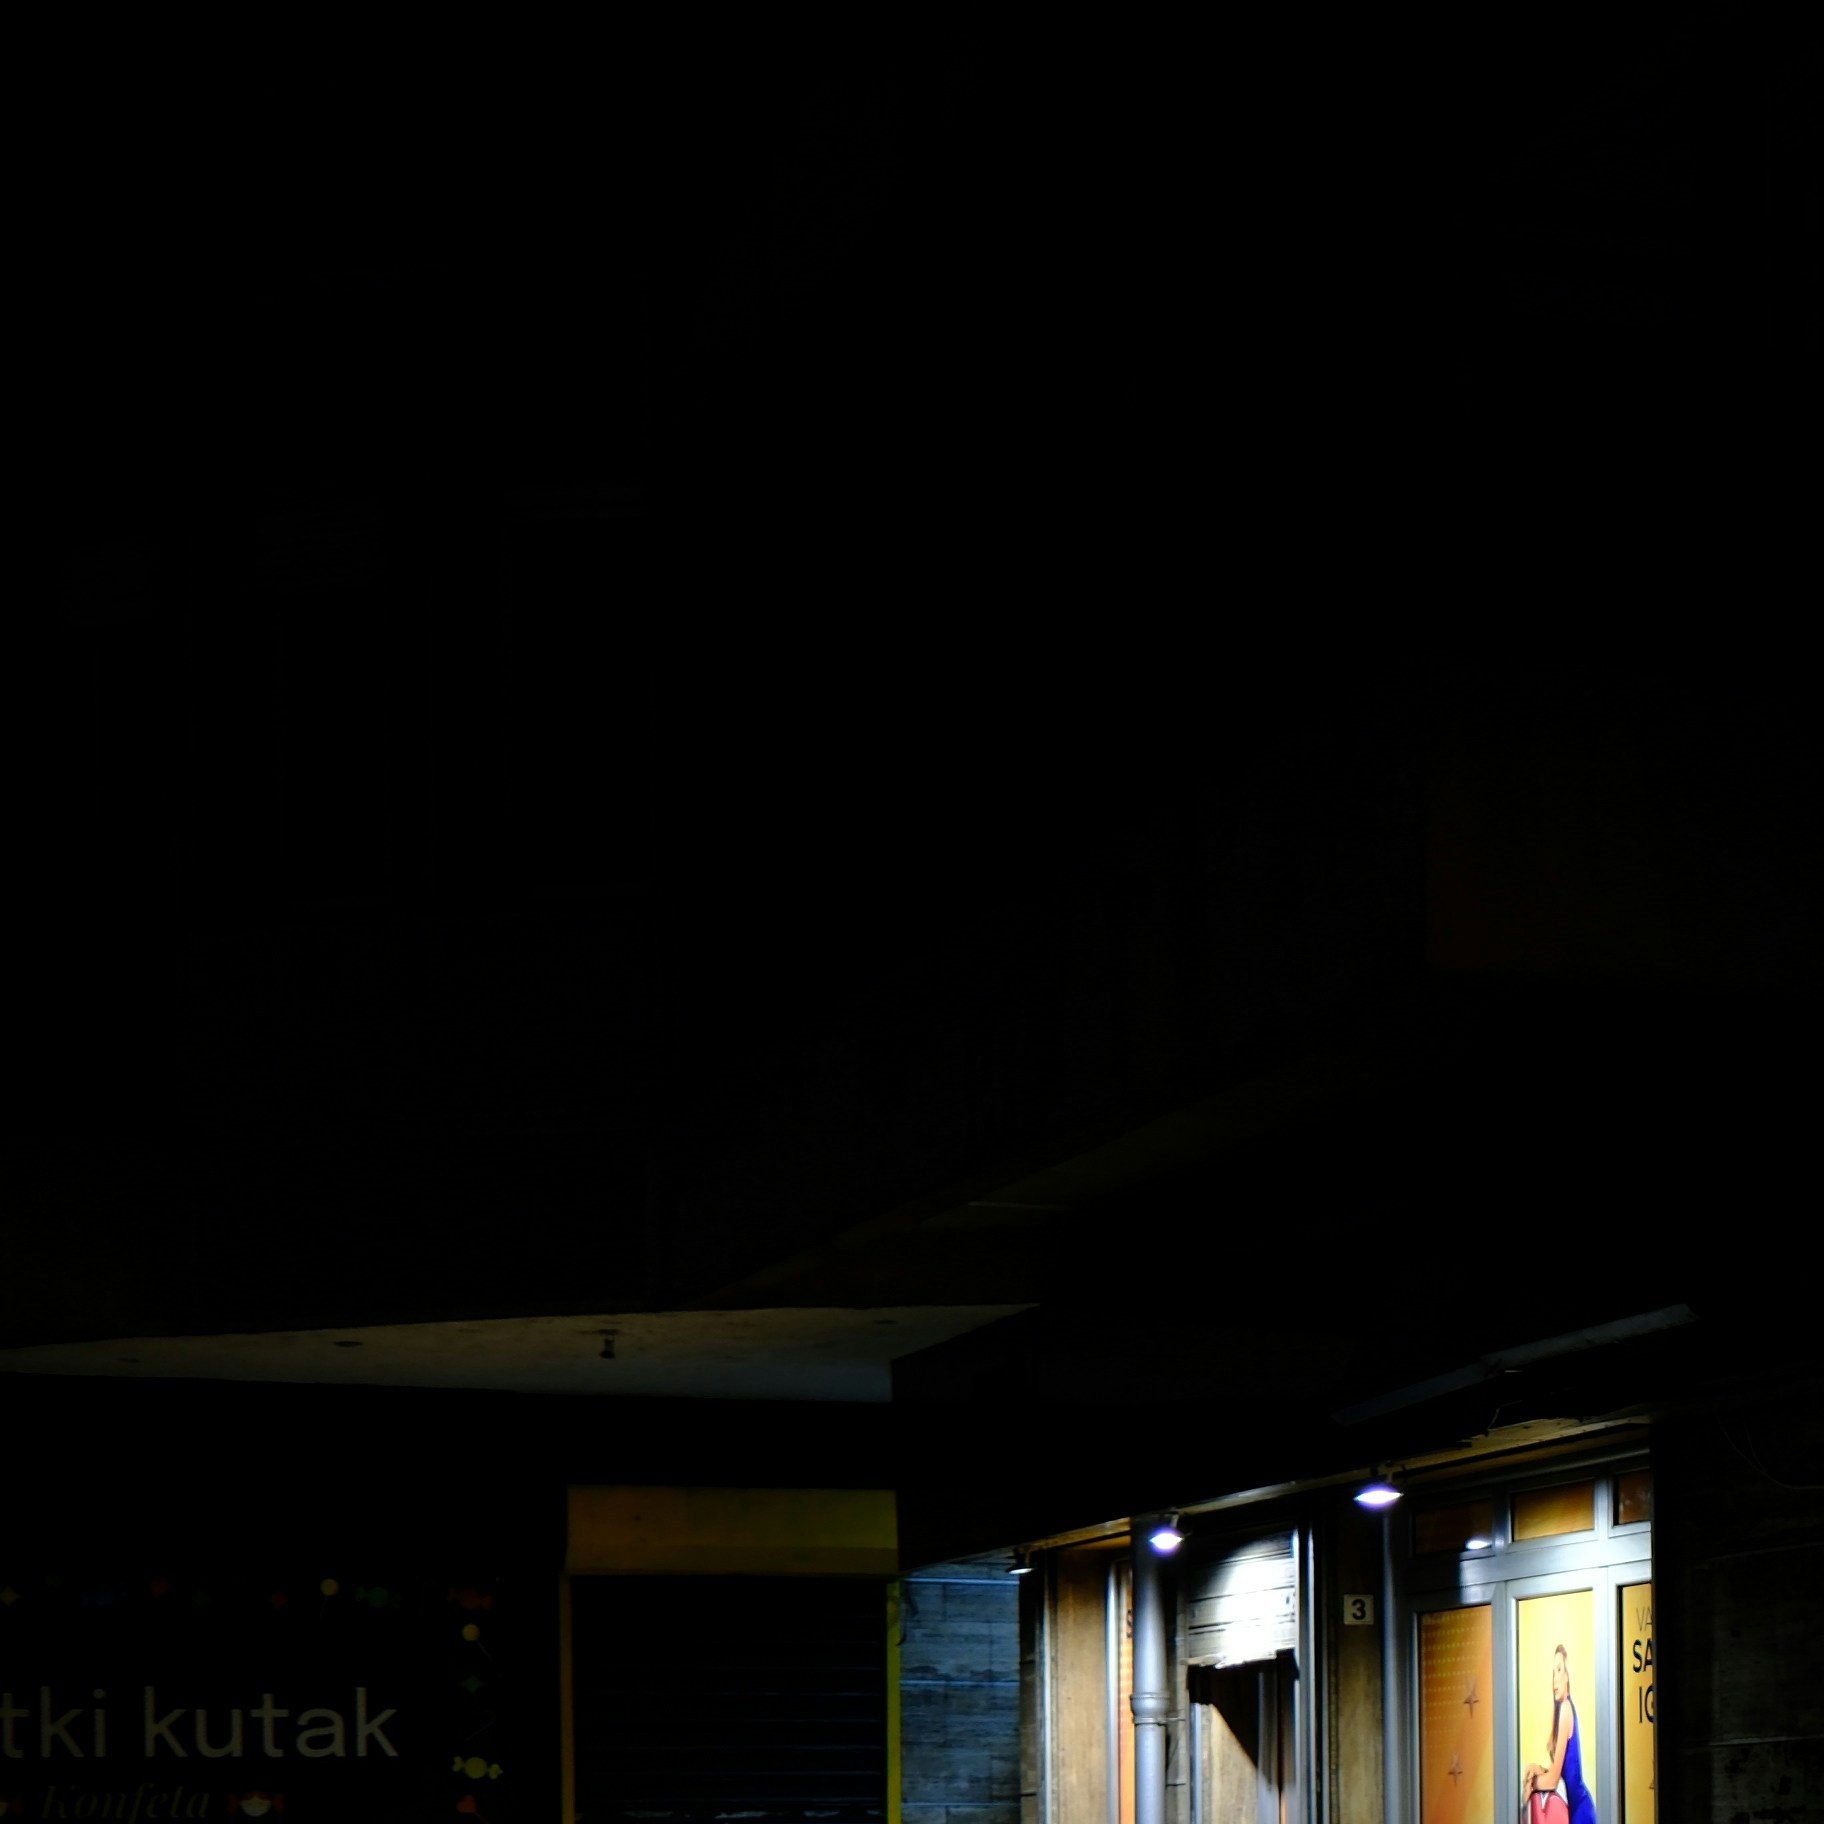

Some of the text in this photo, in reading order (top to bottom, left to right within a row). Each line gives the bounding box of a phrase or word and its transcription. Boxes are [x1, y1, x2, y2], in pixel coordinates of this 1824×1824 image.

[1352, 1599, 1366, 1620] 3
[0, 1684, 400, 1759] tki kutak
